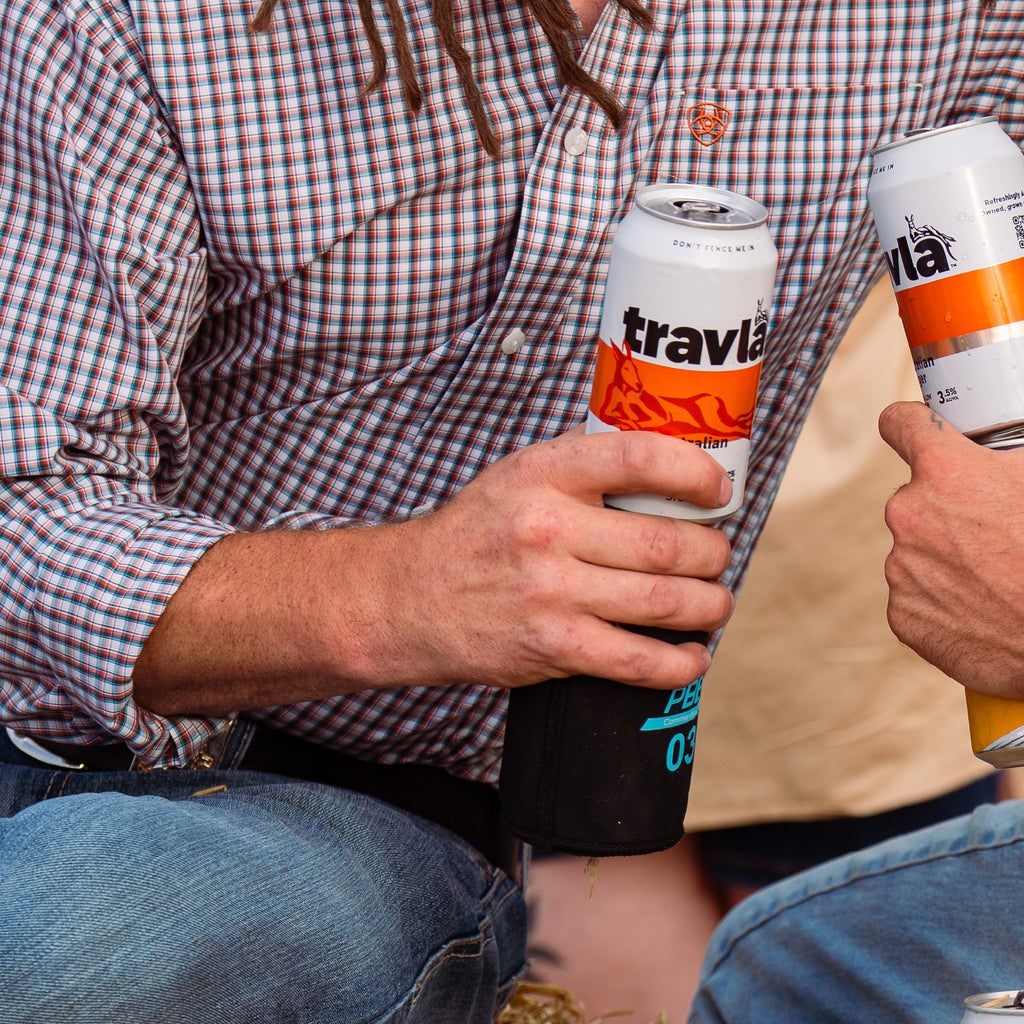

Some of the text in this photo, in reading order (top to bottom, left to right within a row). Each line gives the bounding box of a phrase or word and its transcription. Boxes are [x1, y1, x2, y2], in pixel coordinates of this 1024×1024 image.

[984, 191, 1021, 206] Refreshingly
[705, 244, 732, 253] FENCE
[622, 306, 767, 365] travla
